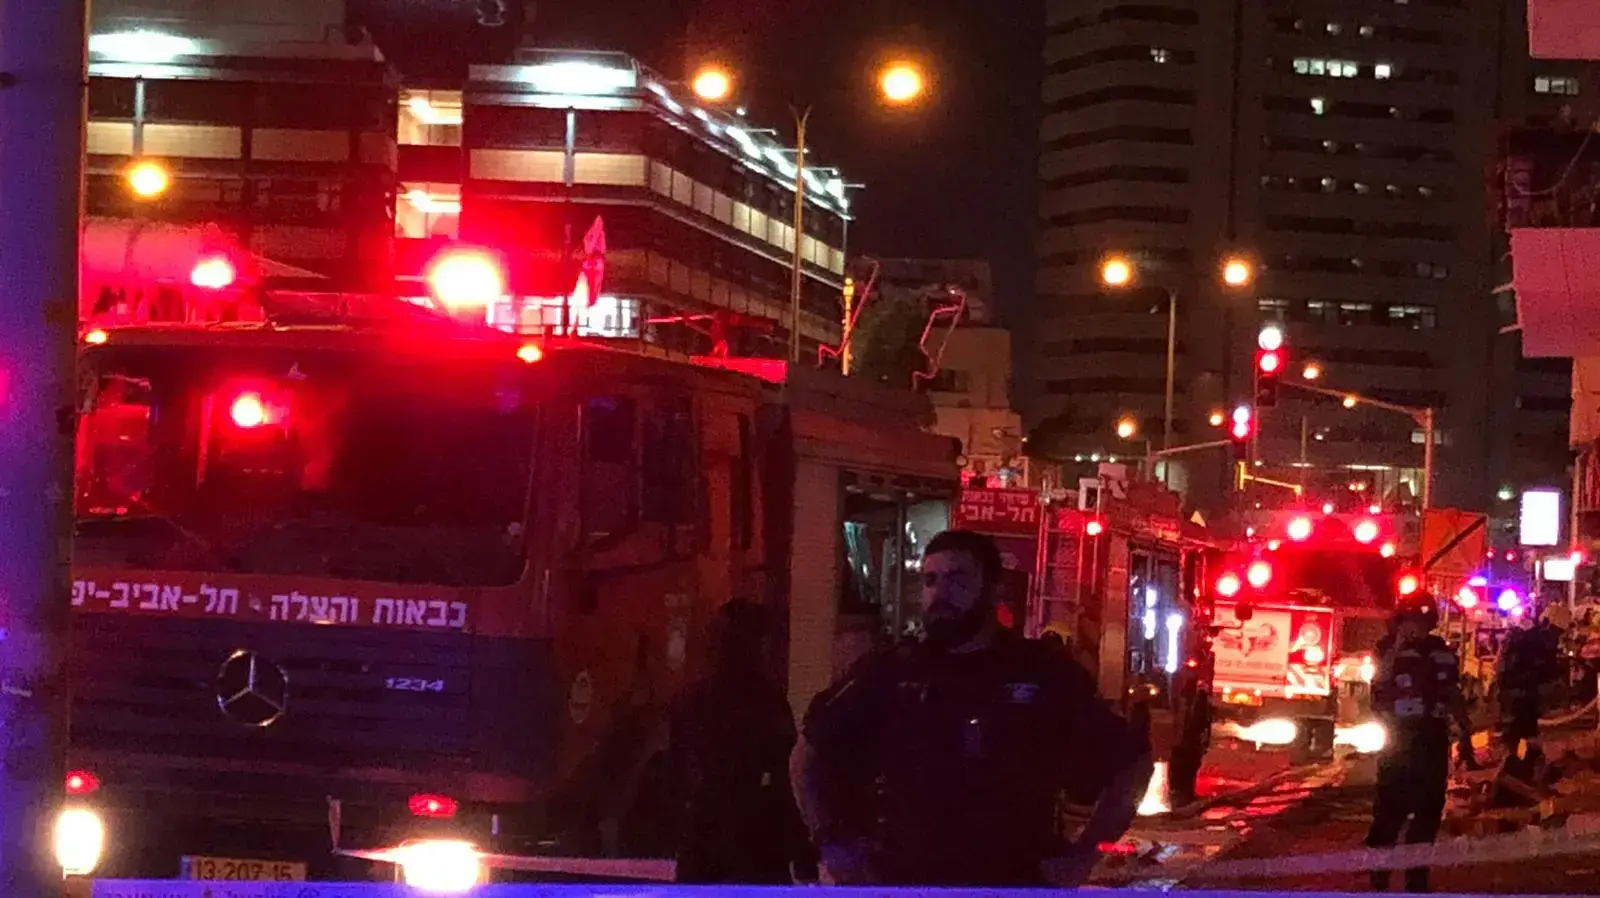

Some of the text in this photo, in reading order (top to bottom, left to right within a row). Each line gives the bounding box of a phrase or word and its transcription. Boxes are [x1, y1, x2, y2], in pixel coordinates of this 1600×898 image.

[269, 591, 359, 624] והצלה
[373, 597, 468, 628] כבאות
[385, 676, 444, 692] 1234
